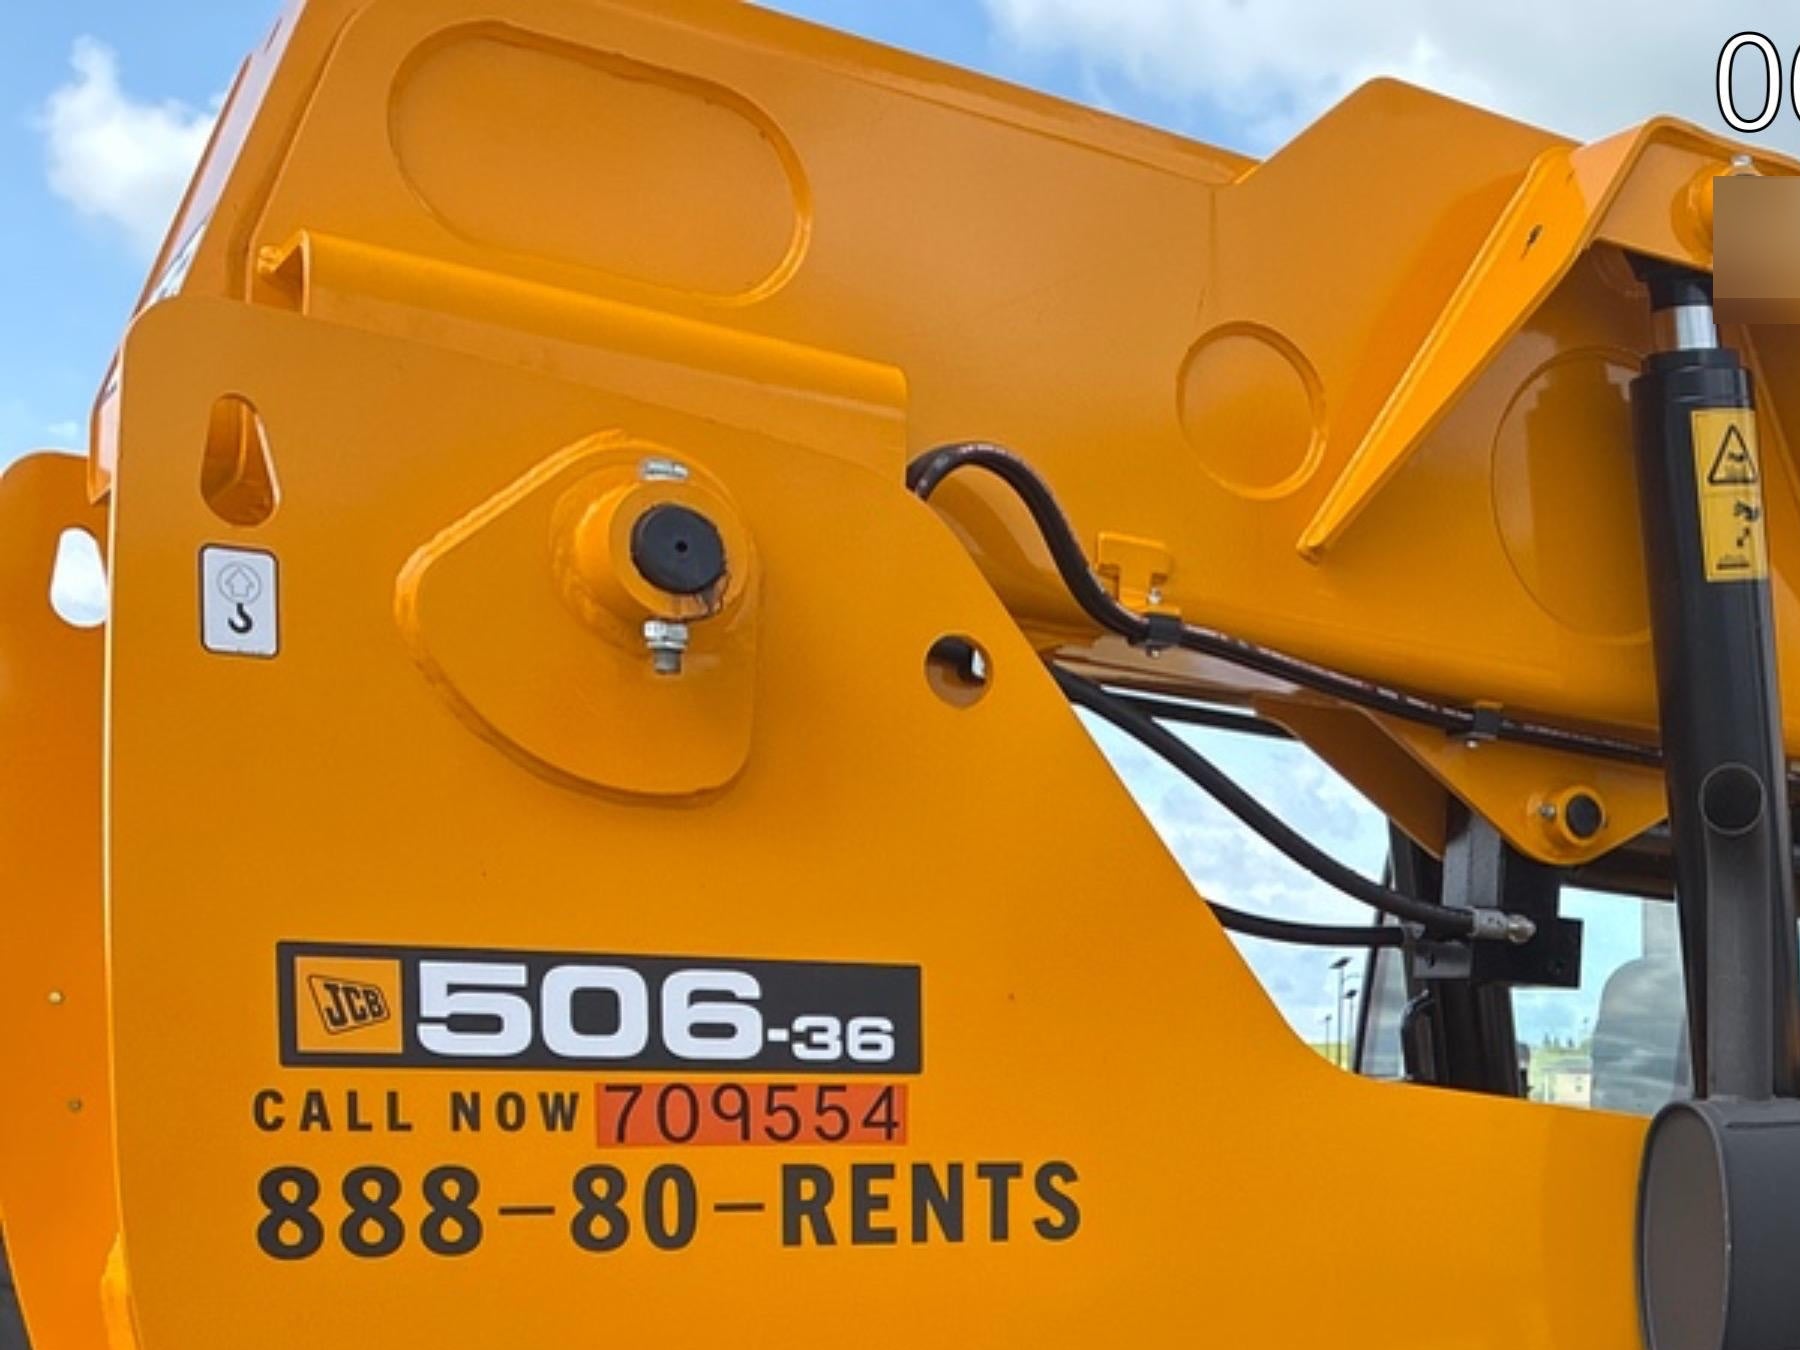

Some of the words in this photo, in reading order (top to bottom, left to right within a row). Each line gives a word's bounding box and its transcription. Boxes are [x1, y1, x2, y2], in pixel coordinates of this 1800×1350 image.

[323, 982, 386, 1027] JCB
[417, 959, 896, 1062] 506-36
[253, 1088, 413, 1133] CALL
[450, 1090, 580, 1133] NOW
[604, 1085, 900, 1144] 709554
